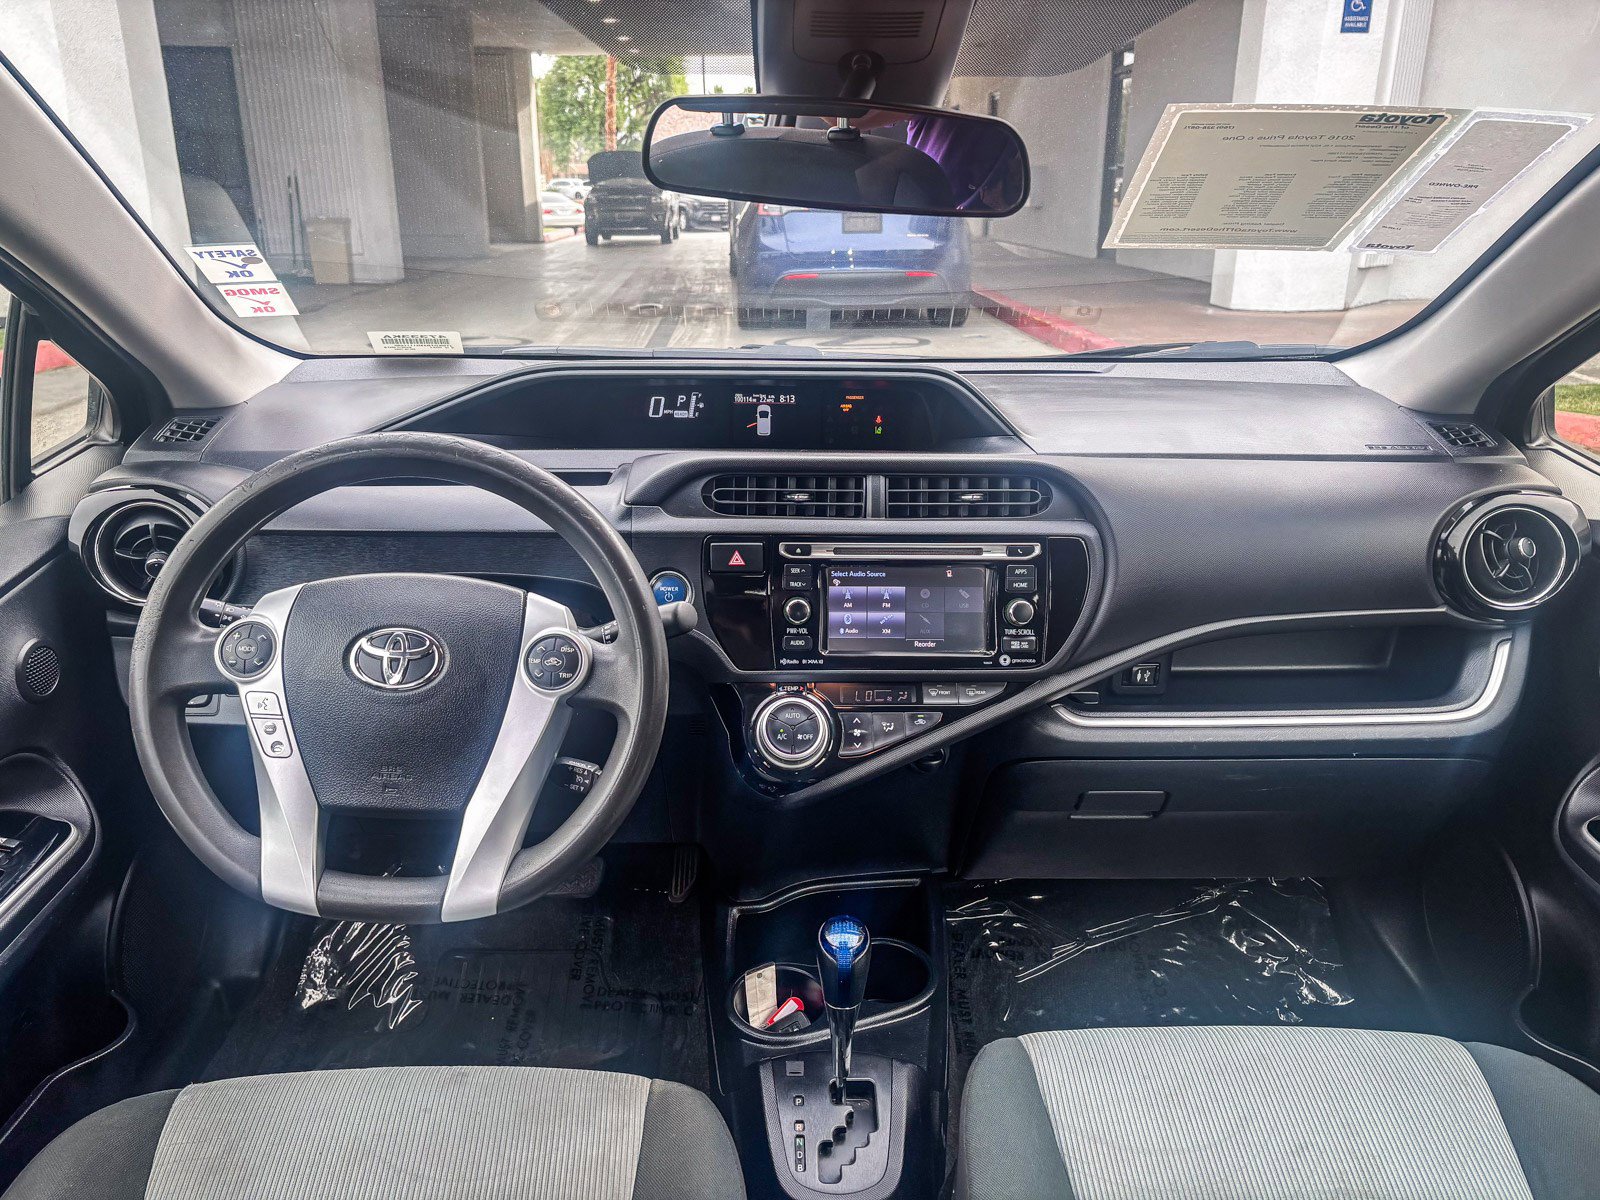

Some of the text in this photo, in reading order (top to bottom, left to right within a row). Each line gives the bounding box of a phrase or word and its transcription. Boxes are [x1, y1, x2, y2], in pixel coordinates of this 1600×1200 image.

[677, 395, 686, 407] P
[780, 394, 796, 403] 8:13
[1004, 628, 1035, 636] TUNE-SCROLL
[803, 733, 814, 741] OFF
[795, 1098, 802, 1106] P
[796, 1138, 803, 1146] N
[797, 1151, 803, 1159] D
[797, 1164, 803, 1172] B
